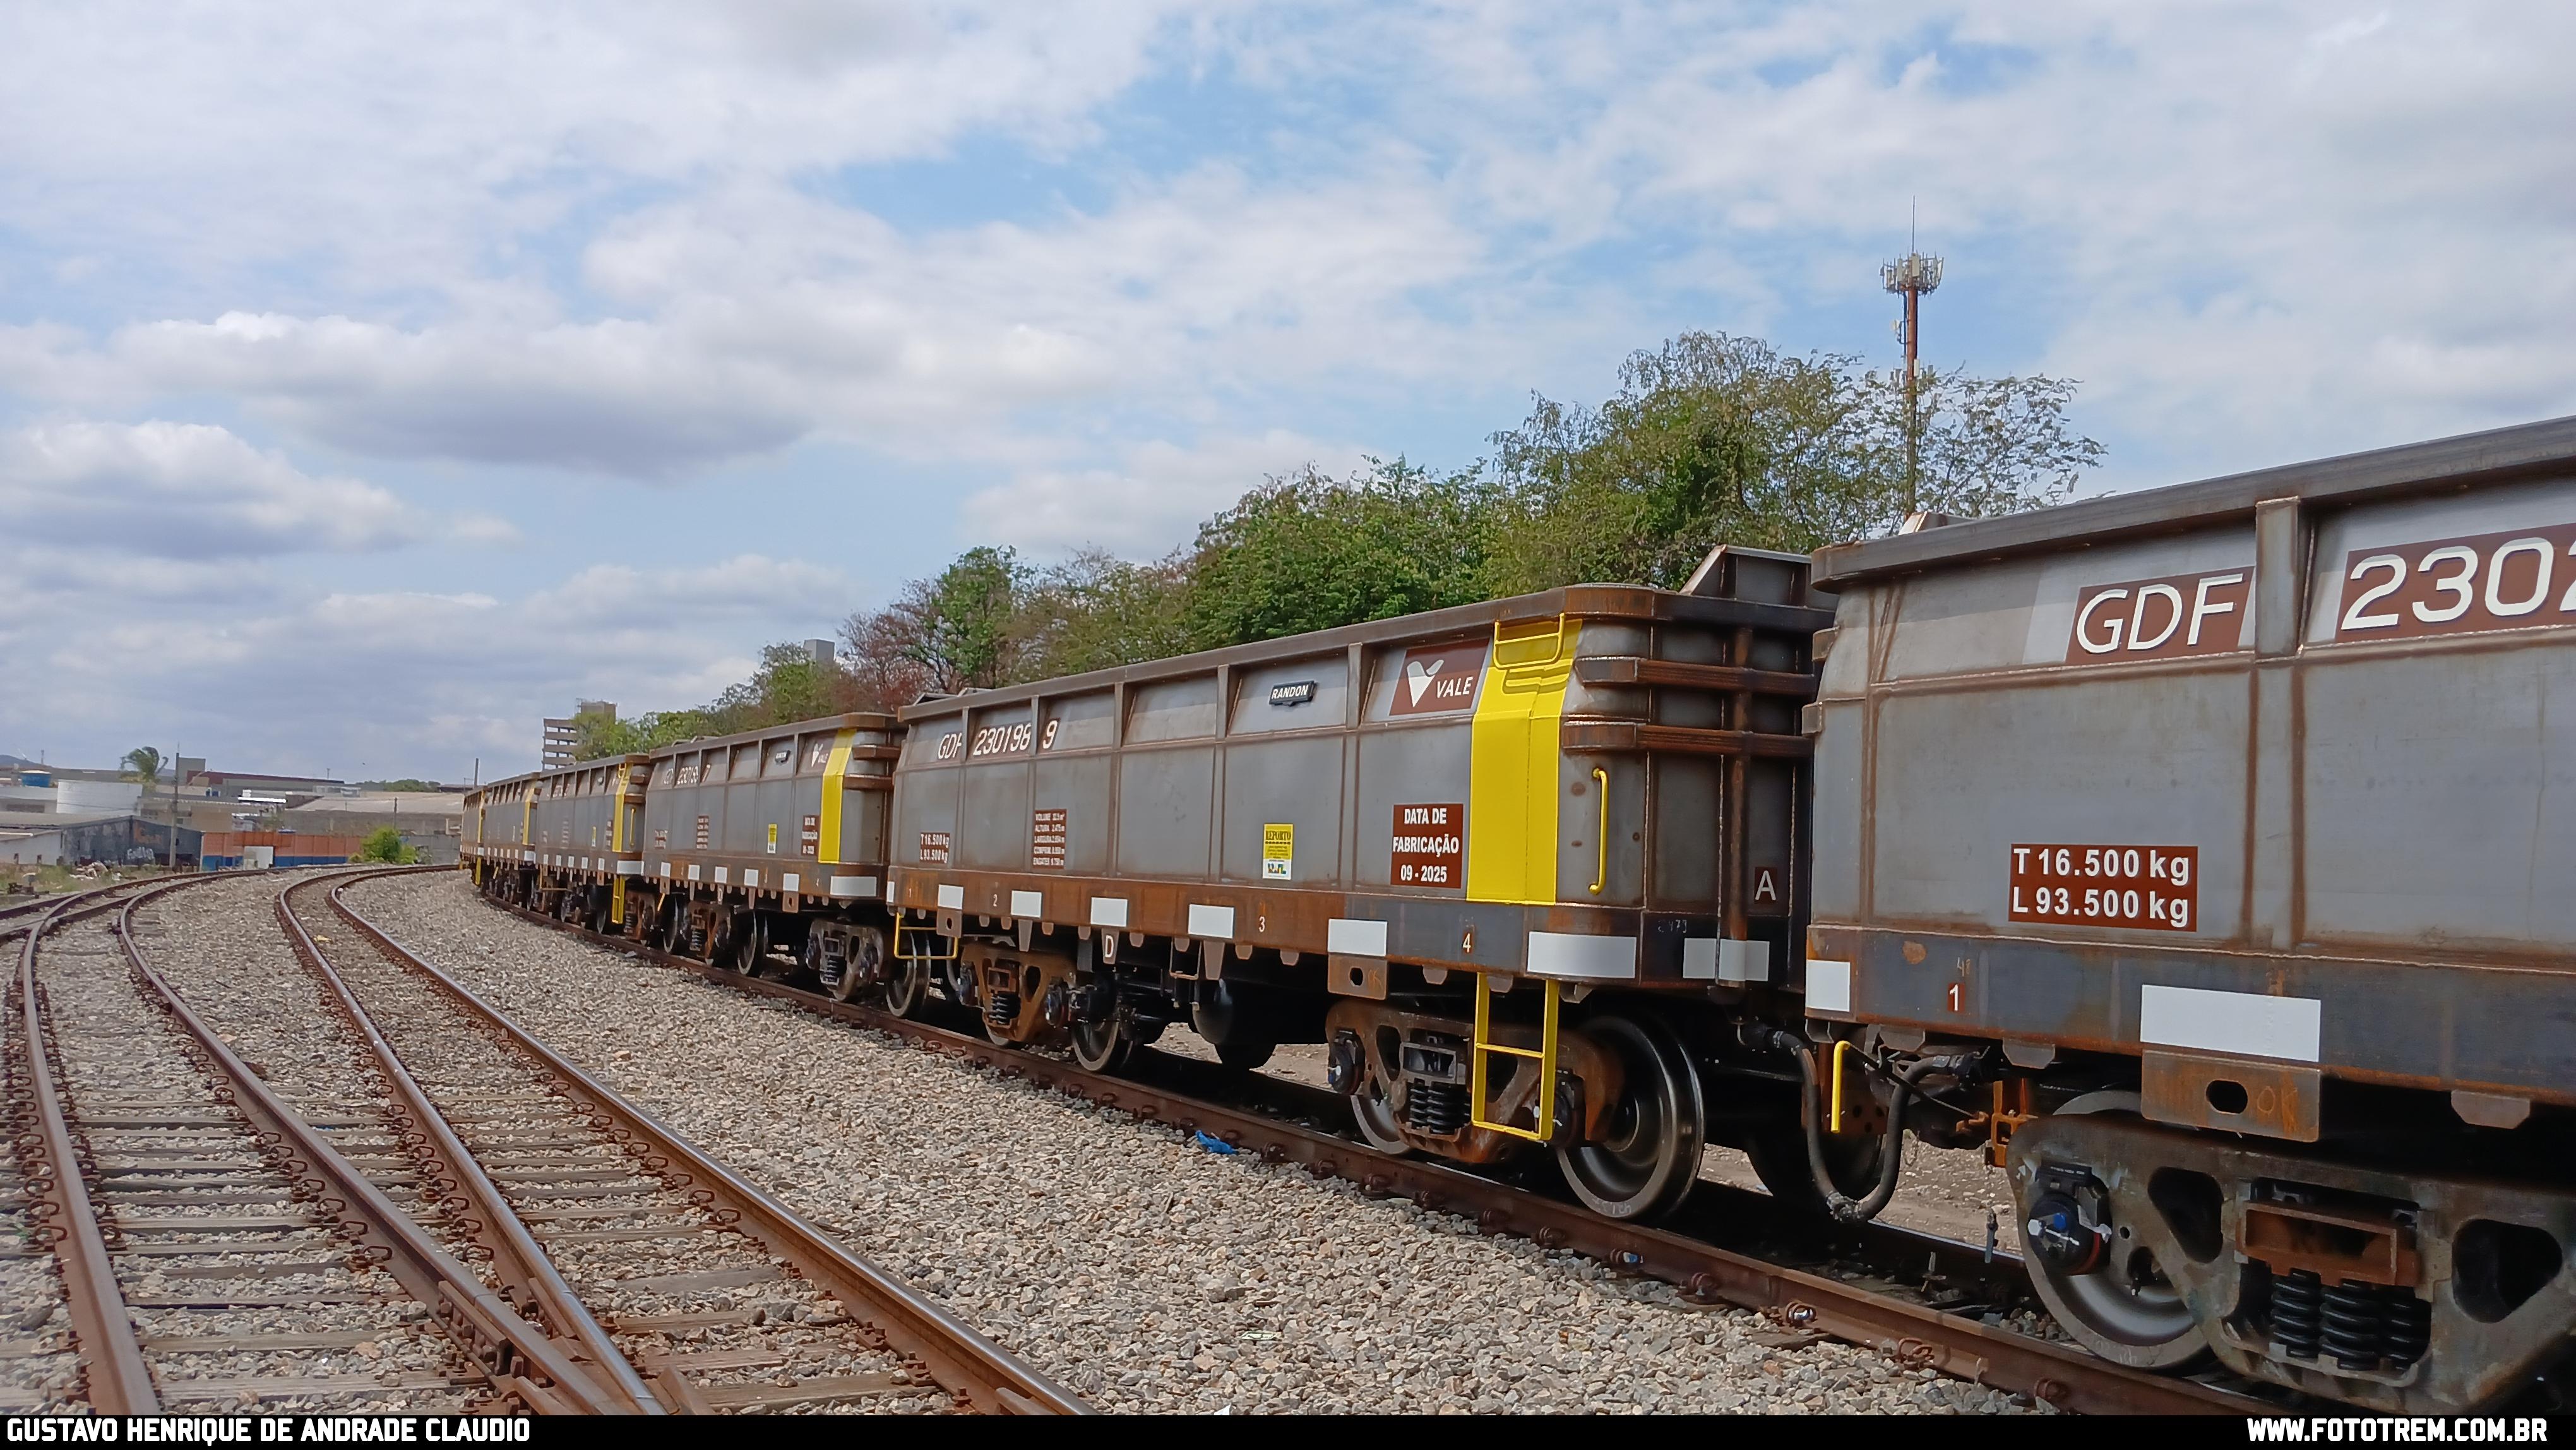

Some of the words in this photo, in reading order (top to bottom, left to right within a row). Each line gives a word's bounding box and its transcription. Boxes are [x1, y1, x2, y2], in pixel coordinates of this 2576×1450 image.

[2076, 573, 2243, 654] GDF
[2341, 537, 2576, 630] 230
[1271, 685, 1309, 700] RANDON
[1436, 676, 1474, 698] VALE
[973, 722, 1031, 755] 230198
[1042, 720, 1058, 749] 9
[1404, 808, 1429, 824] DATA
[1432, 808, 1447, 824] DE
[1393, 834, 1459, 858] FABRICAÇÃO
[1400, 864, 1413, 881] 09
[1421, 865, 1447, 882] 2025
[2014, 848, 2030, 874] T
[2039, 849, 2139, 878] 16.500
[2150, 849, 2188, 886] kg
[1755, 870, 1777, 901] A
[993, 894, 998, 907] 2
[2013, 887, 2029, 913] L
[2036, 887, 2139, 918] 93.500
[2149, 890, 2188, 928] kg
[1259, 916, 1266, 932] 3
[1105, 935, 1114, 958] D
[1462, 933, 1471, 953] 4
[1949, 984, 1959, 1011] 1
